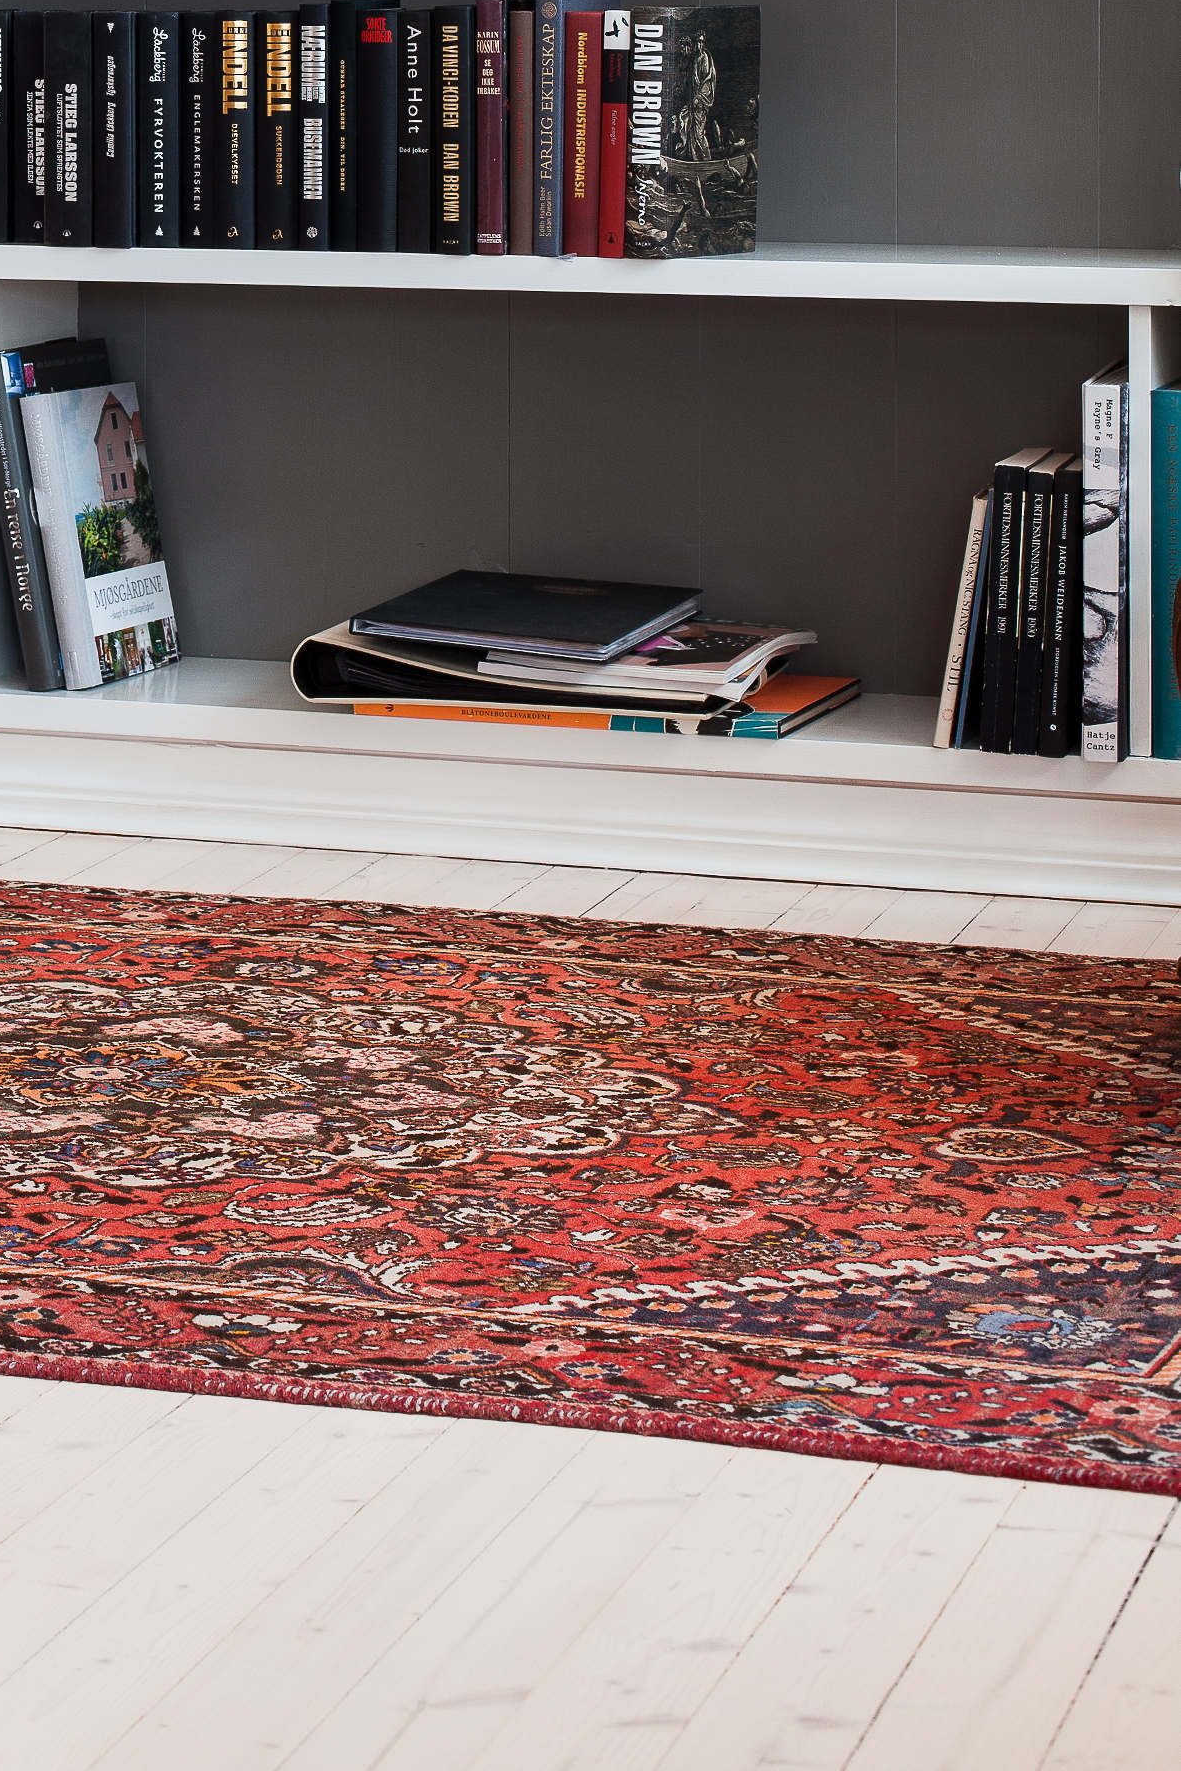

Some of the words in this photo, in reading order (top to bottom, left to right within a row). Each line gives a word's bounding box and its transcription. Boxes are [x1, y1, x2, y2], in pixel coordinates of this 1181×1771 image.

[301, 24, 326, 87] NÆRUM
[406, 24, 423, 80] Anne
[441, 25, 459, 43] DA
[476, 30, 499, 39] KARIN
[476, 39, 501, 54] FOSSUM
[576, 31, 588, 85] Nordblom
[633, 23, 664, 72] DAN
[222, 19, 248, 115] LINDELL
[266, 22, 292, 117] LINDELL
[442, 44, 460, 129] VINCI-KODEN
[541, 21, 555, 111] EKTESKAP
[64, 82, 78, 129] STIEG
[407, 87, 423, 134] Holt
[631, 79, 663, 166] BROWN
[35, 127, 45, 197] LARSSON
[64, 132, 78, 203] LARSSON
[153, 97, 164, 213] FYRVOKTEREN
[193, 94, 201, 211] ENGLEMAKERSKEN
[275, 124, 284, 186] SUKKERDØDEN
[303, 117, 323, 200] BUSEMANNEN
[442, 142, 460, 170] DAN
[539, 117, 553, 180] FARLIG
[574, 88, 587, 199] INDUSTRISPIONASJE
[56, 154, 64, 192] SPRENGTES
[443, 174, 460, 222] BROWN
[634, 174, 655, 227] Inferno
[1091, 401, 1104, 443] Payne's
[1103, 398, 1114, 431] Magne
[1091, 445, 1103, 471] Gray
[7, 512, 24, 550] reise
[967, 527, 984, 566] RAGNA
[997, 491, 1014, 610] FORTIDSMINNESMERKER
[1027, 492, 1045, 611] FORTIDSMINNESMERKER
[1057, 544, 1068, 576] JAKOB
[13, 562, 36, 613] Norge
[92, 573, 164, 611] MJØSGÅRDENE
[1054, 578, 1066, 642] WEIDEMANN
[1086, 730, 1117, 740] Hatje
[1086, 741, 1117, 750] Cantz
